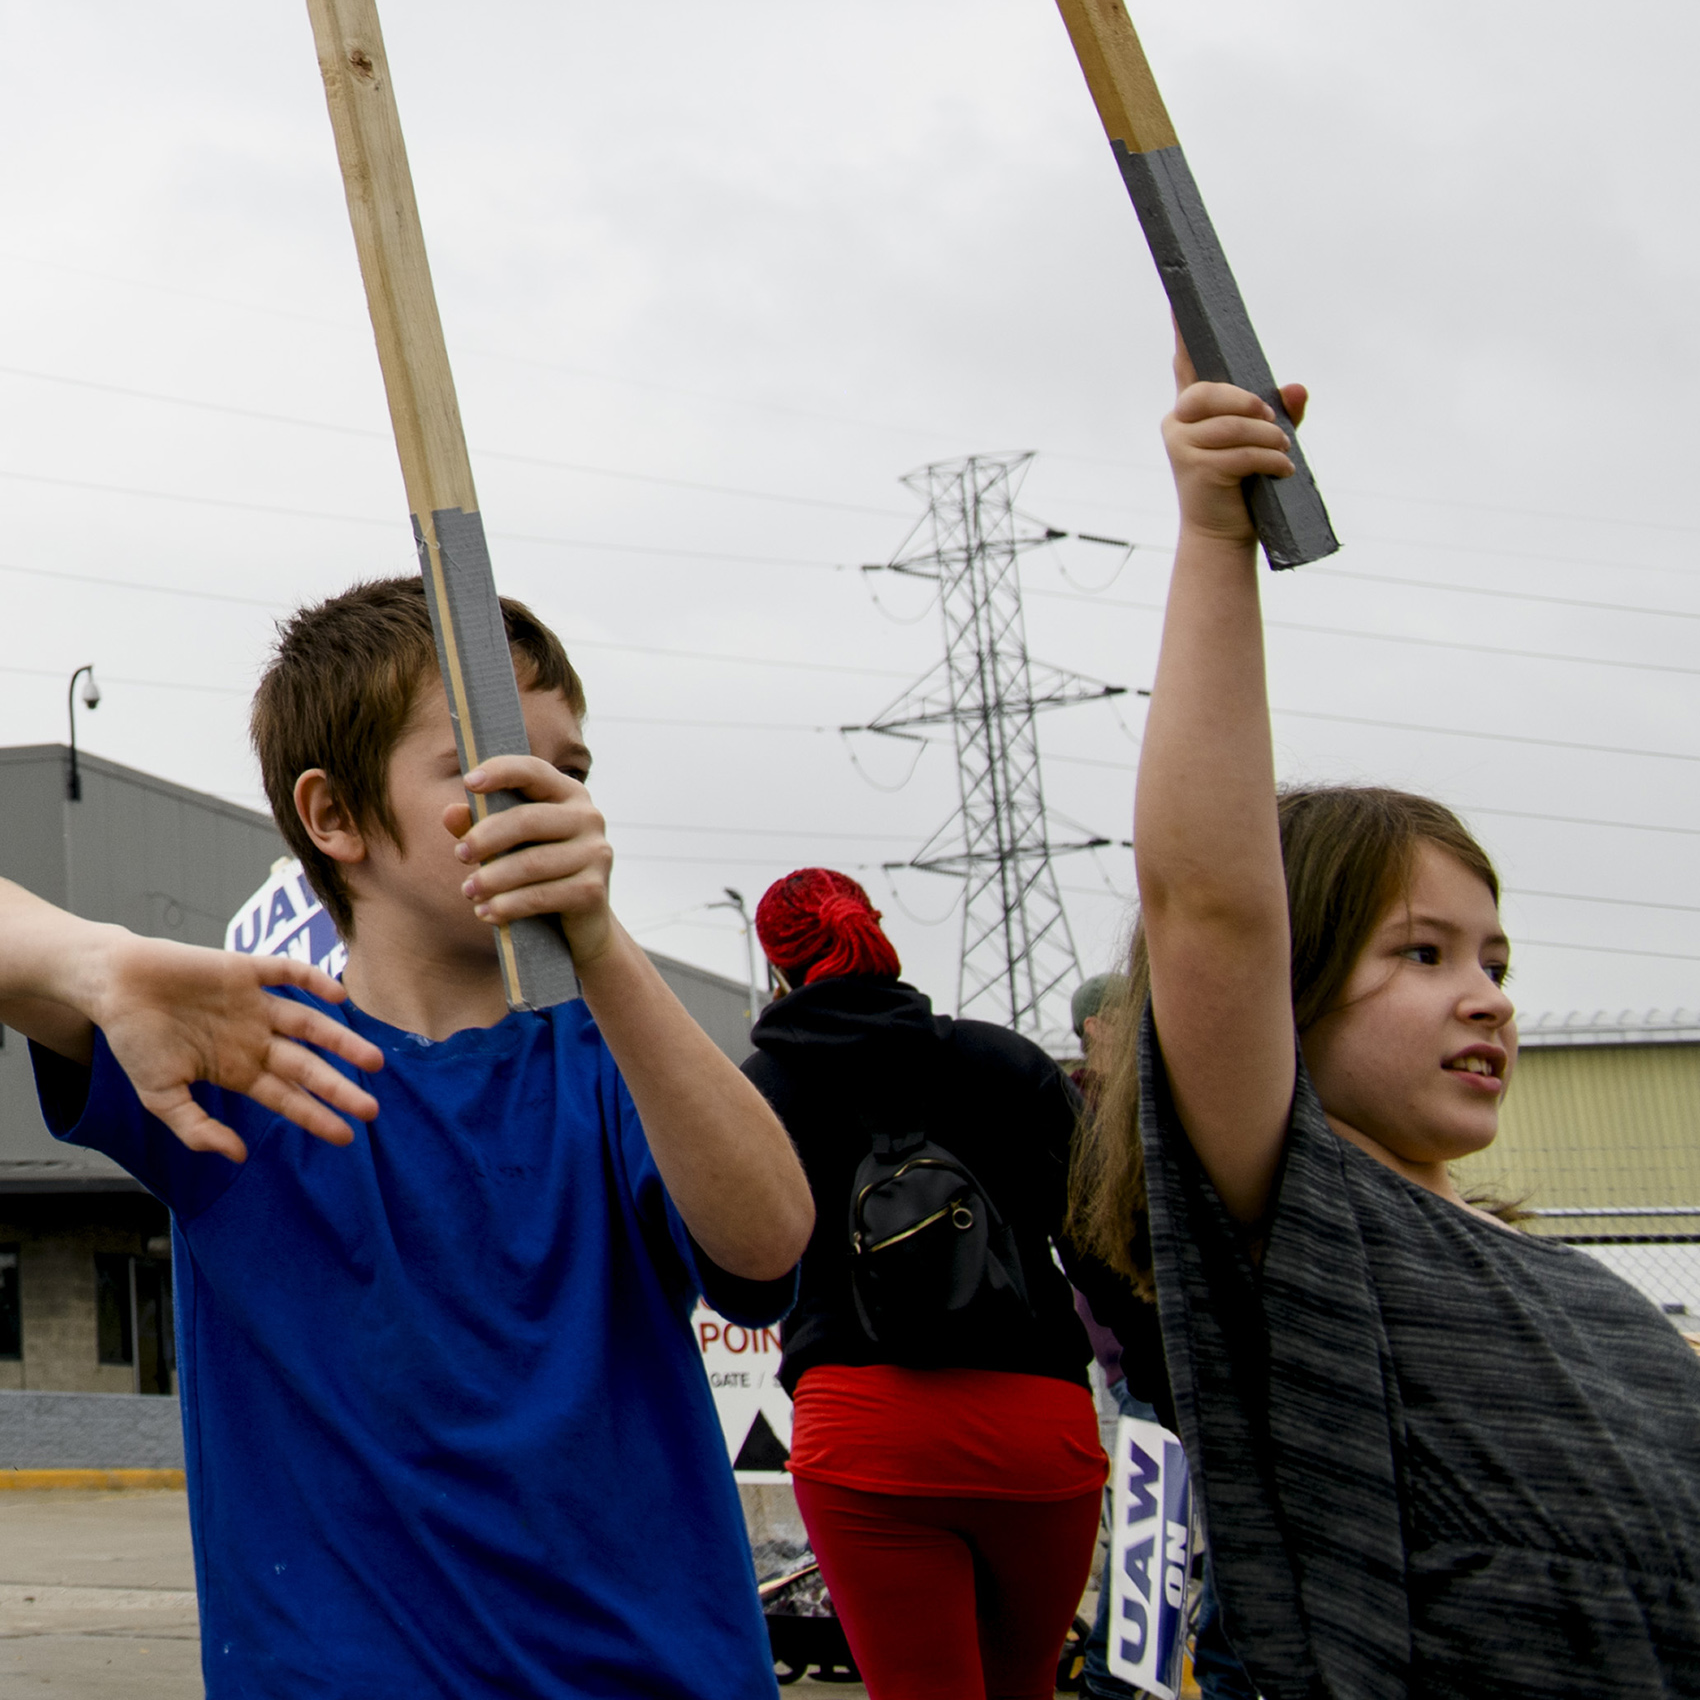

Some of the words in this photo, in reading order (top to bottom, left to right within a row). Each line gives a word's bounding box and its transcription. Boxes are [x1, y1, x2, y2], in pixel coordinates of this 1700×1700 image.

[699, 1321, 783, 1354] POIN
[711, 1371, 752, 1389] GATE
[1120, 1437, 1161, 1665] UAW
[1164, 1519, 1188, 1610] ON
